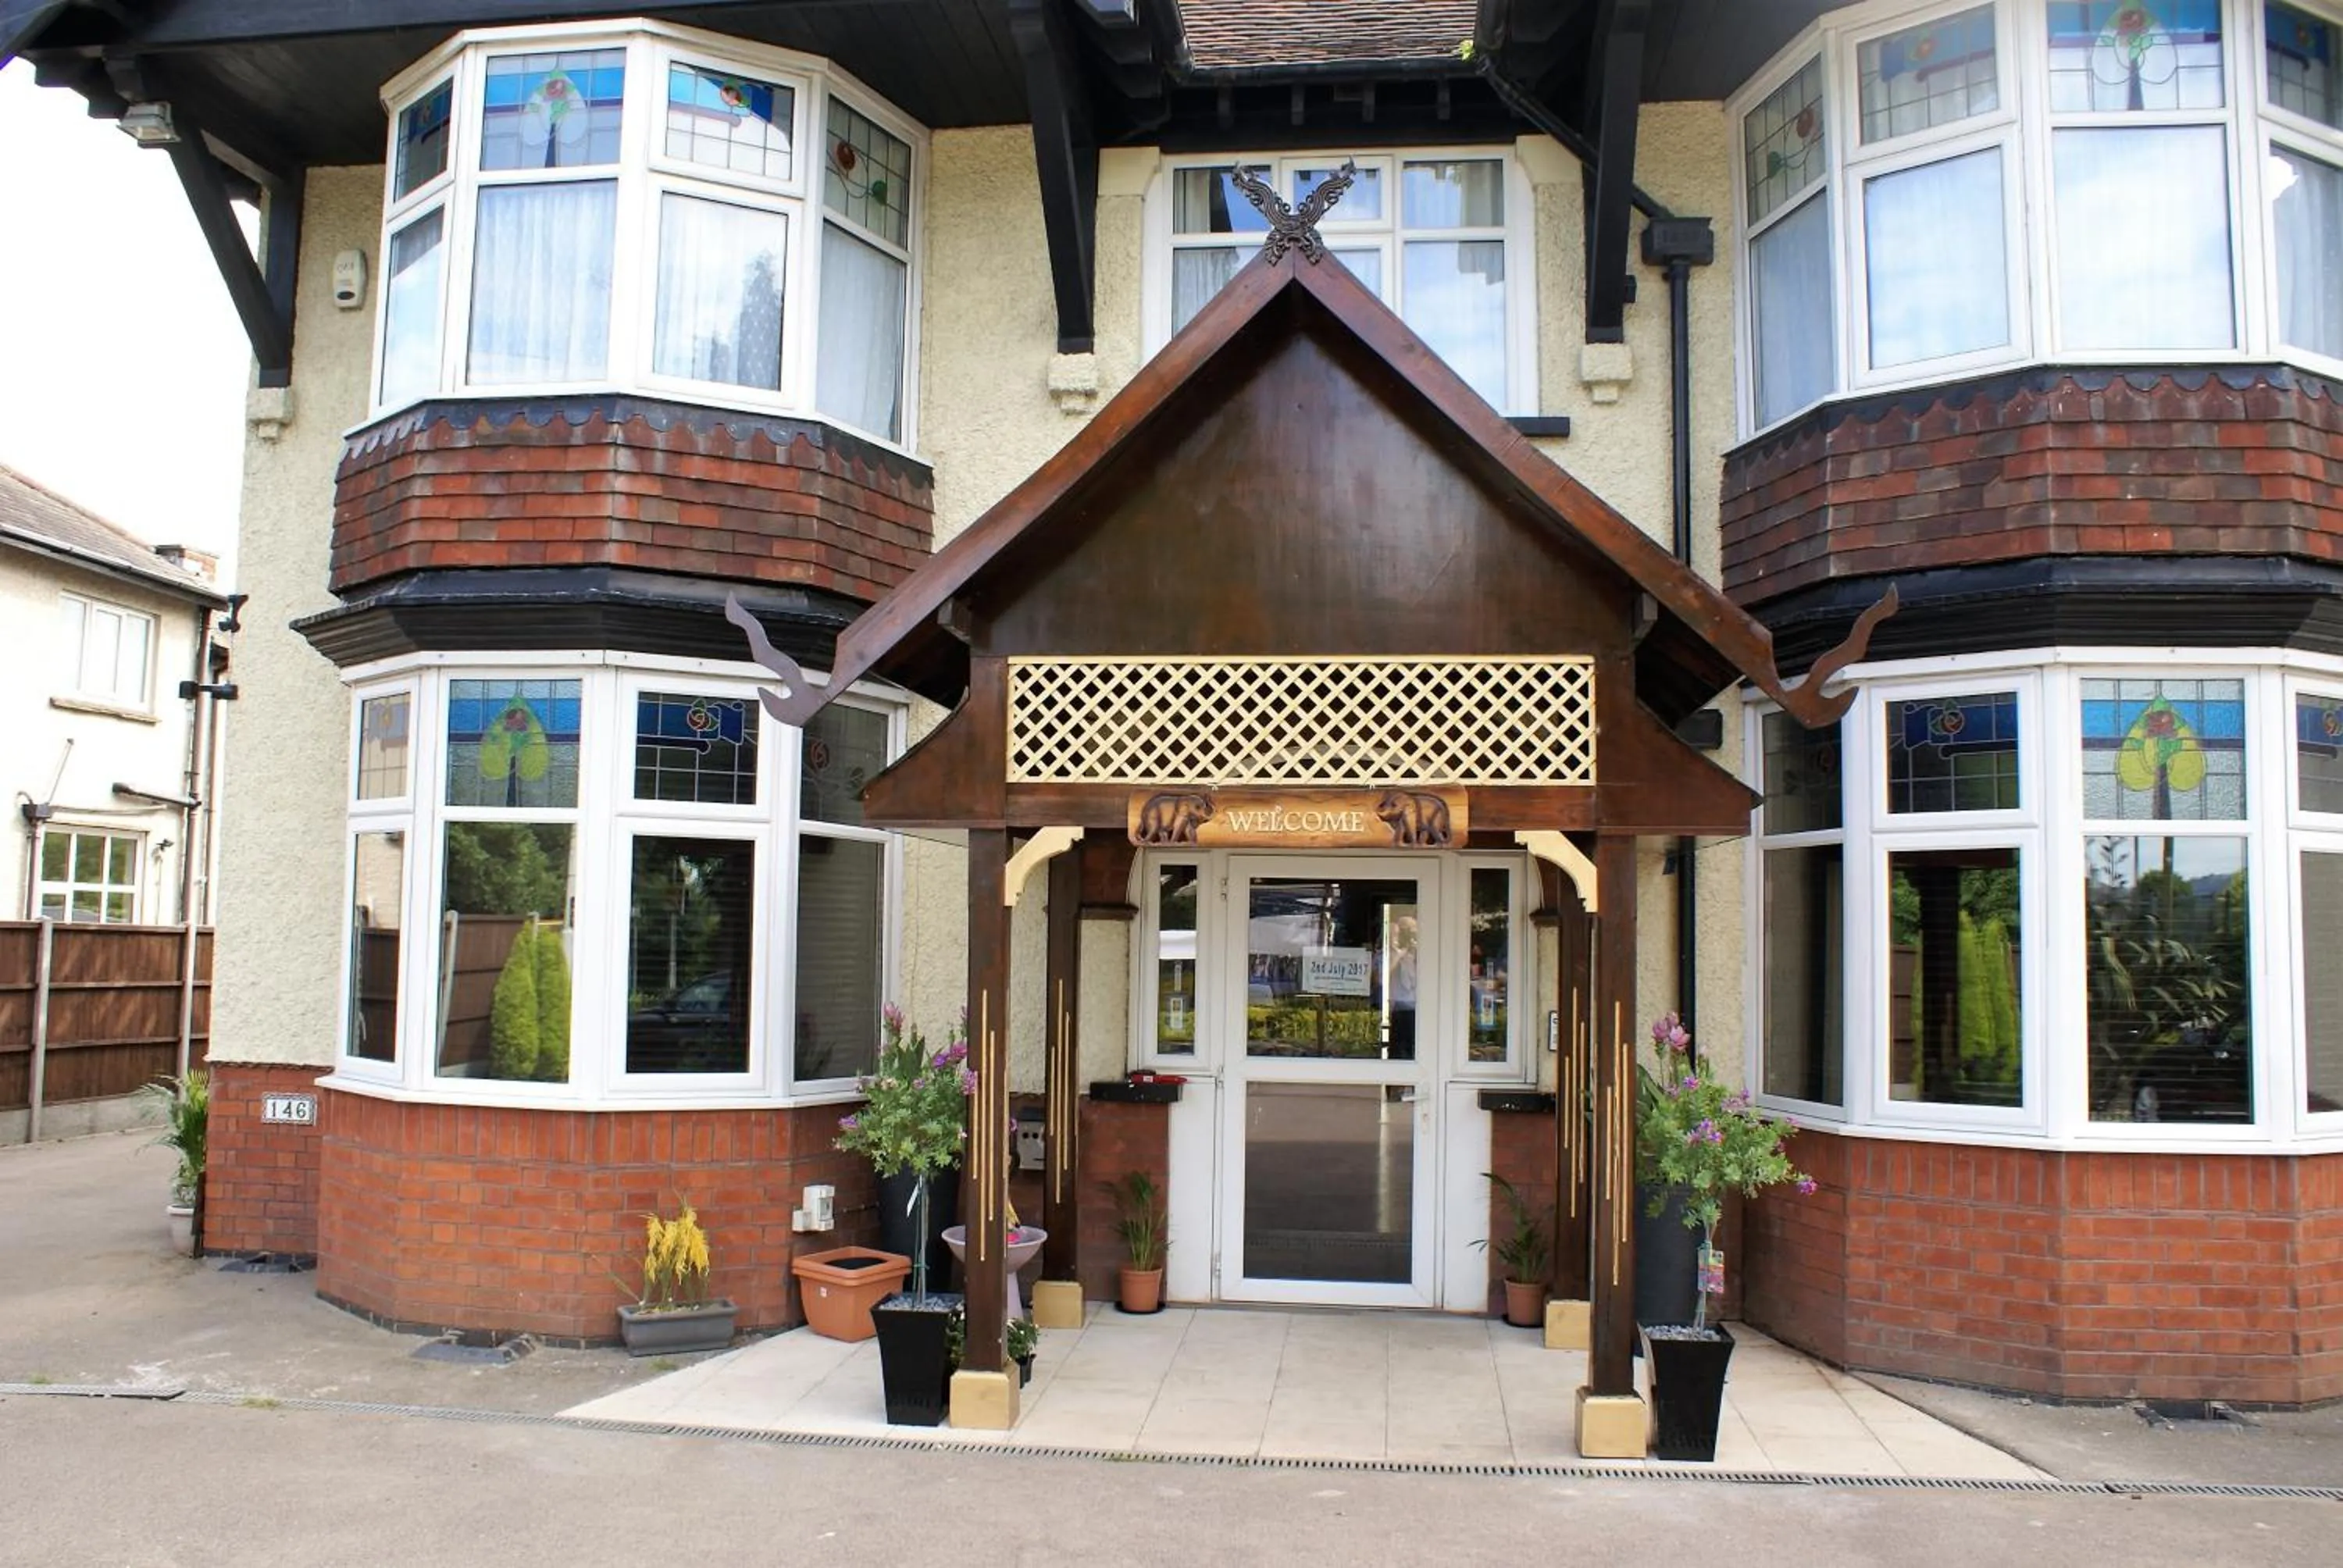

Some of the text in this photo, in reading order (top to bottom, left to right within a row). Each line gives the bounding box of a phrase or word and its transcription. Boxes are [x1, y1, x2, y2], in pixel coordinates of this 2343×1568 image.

[1227, 811, 1364, 832] WELCOME
[1328, 961, 1346, 979] July
[273, 1101, 306, 1118] 146
